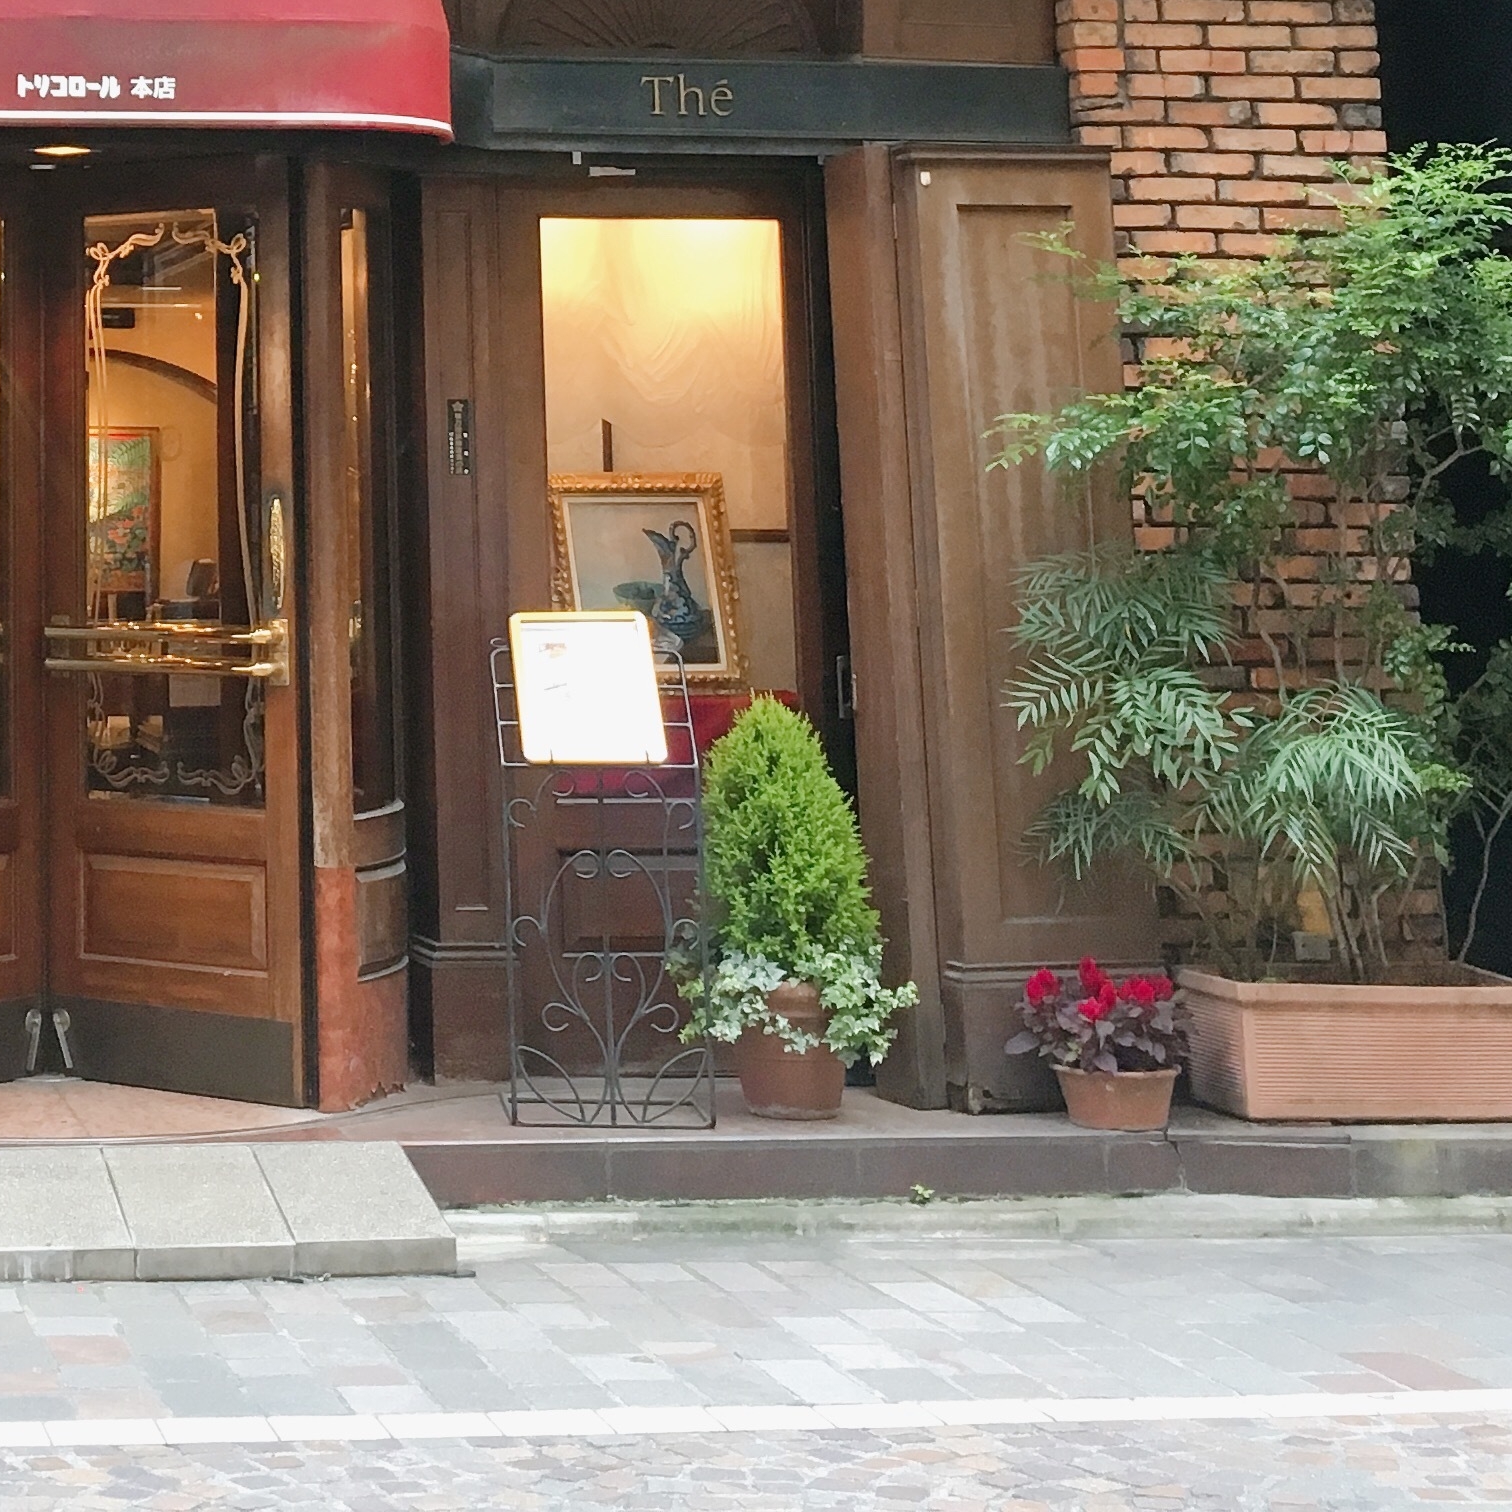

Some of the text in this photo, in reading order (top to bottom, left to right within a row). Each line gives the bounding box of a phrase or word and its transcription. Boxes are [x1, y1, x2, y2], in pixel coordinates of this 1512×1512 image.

[17, 73, 176, 100] トリコロール 本店
[640, 73, 734, 116] Thé
